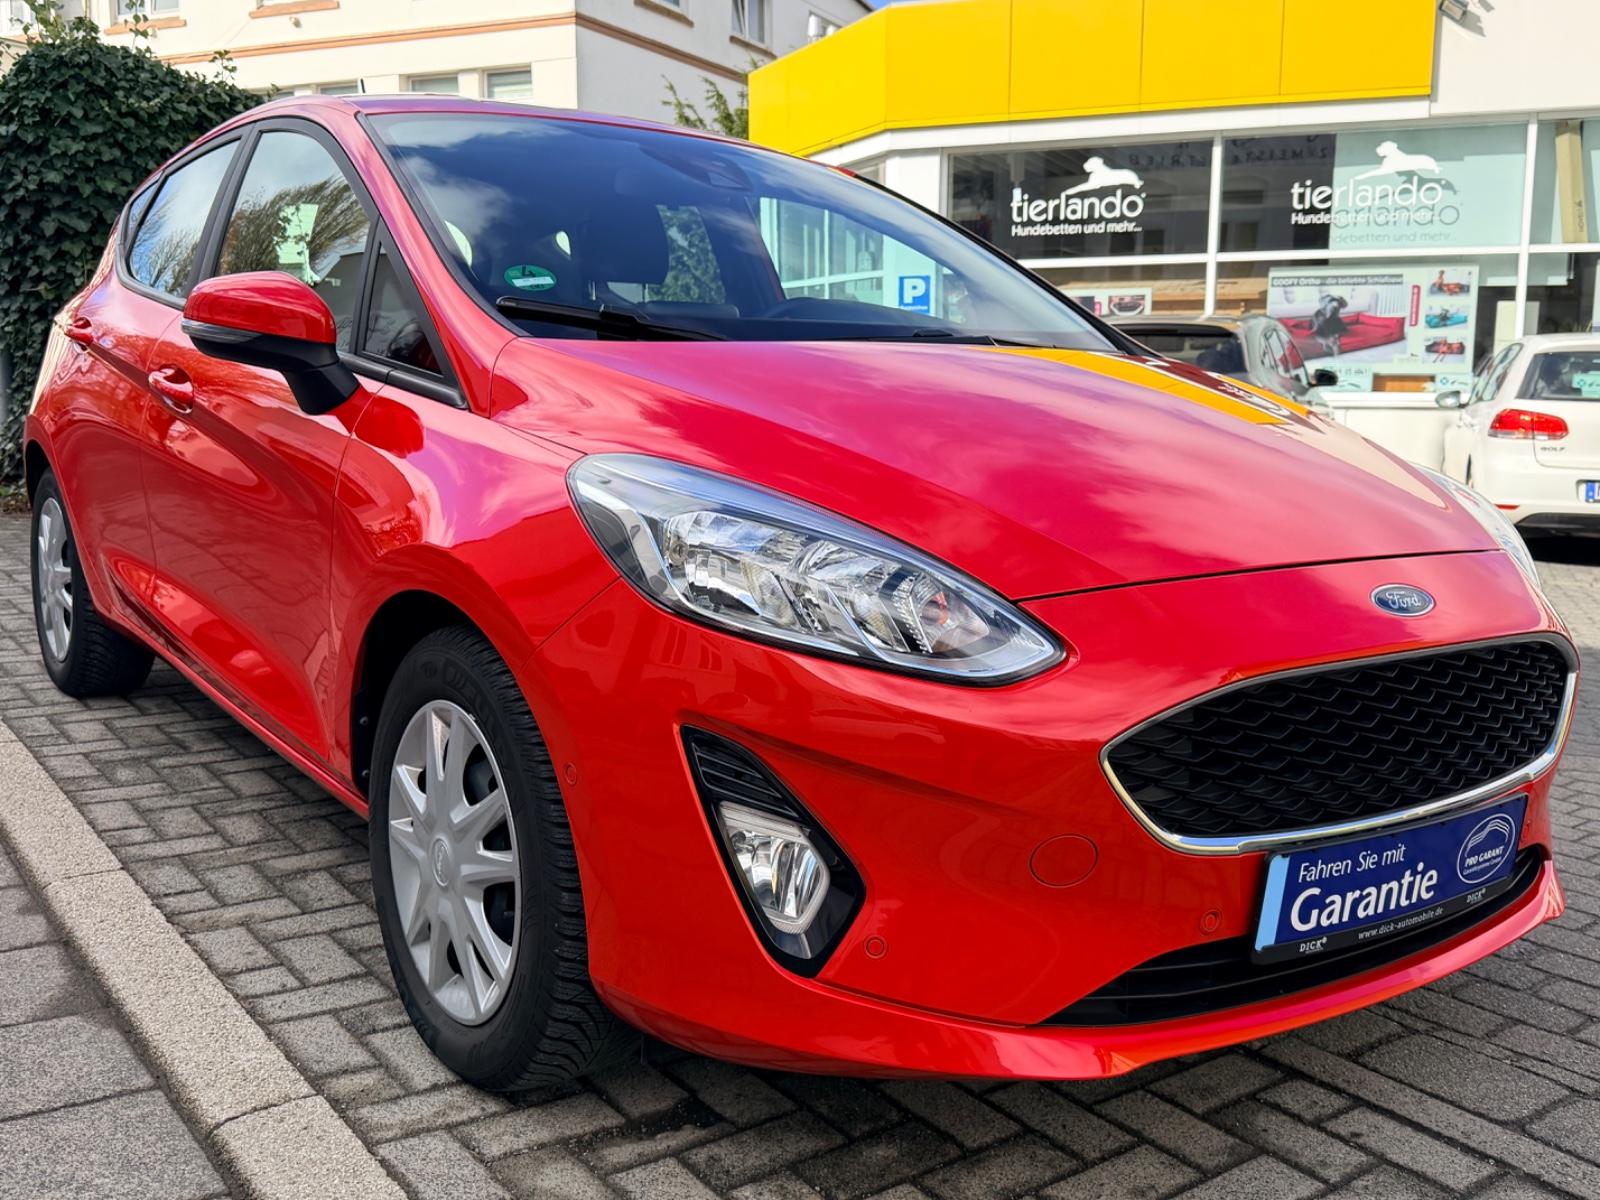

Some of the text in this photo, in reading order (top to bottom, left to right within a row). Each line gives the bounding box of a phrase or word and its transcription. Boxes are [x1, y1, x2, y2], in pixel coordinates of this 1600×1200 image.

[1010, 188, 1145, 222] tierlando
[1291, 175, 1443, 210] tierlando
[1011, 223, 1082, 237] Hundebetten
[1083, 221, 1106, 234] und
[1291, 211, 1373, 225] Hundebetten
[903, 277, 926, 304] P
[1386, 591, 1421, 609] Ford
[1298, 843, 1407, 883] Fahren Sie mit
[1478, 845, 1505, 863] GARANT
[1290, 861, 1439, 932] Garantie
[1358, 907, 1444, 940] www.dick-automobile.de
